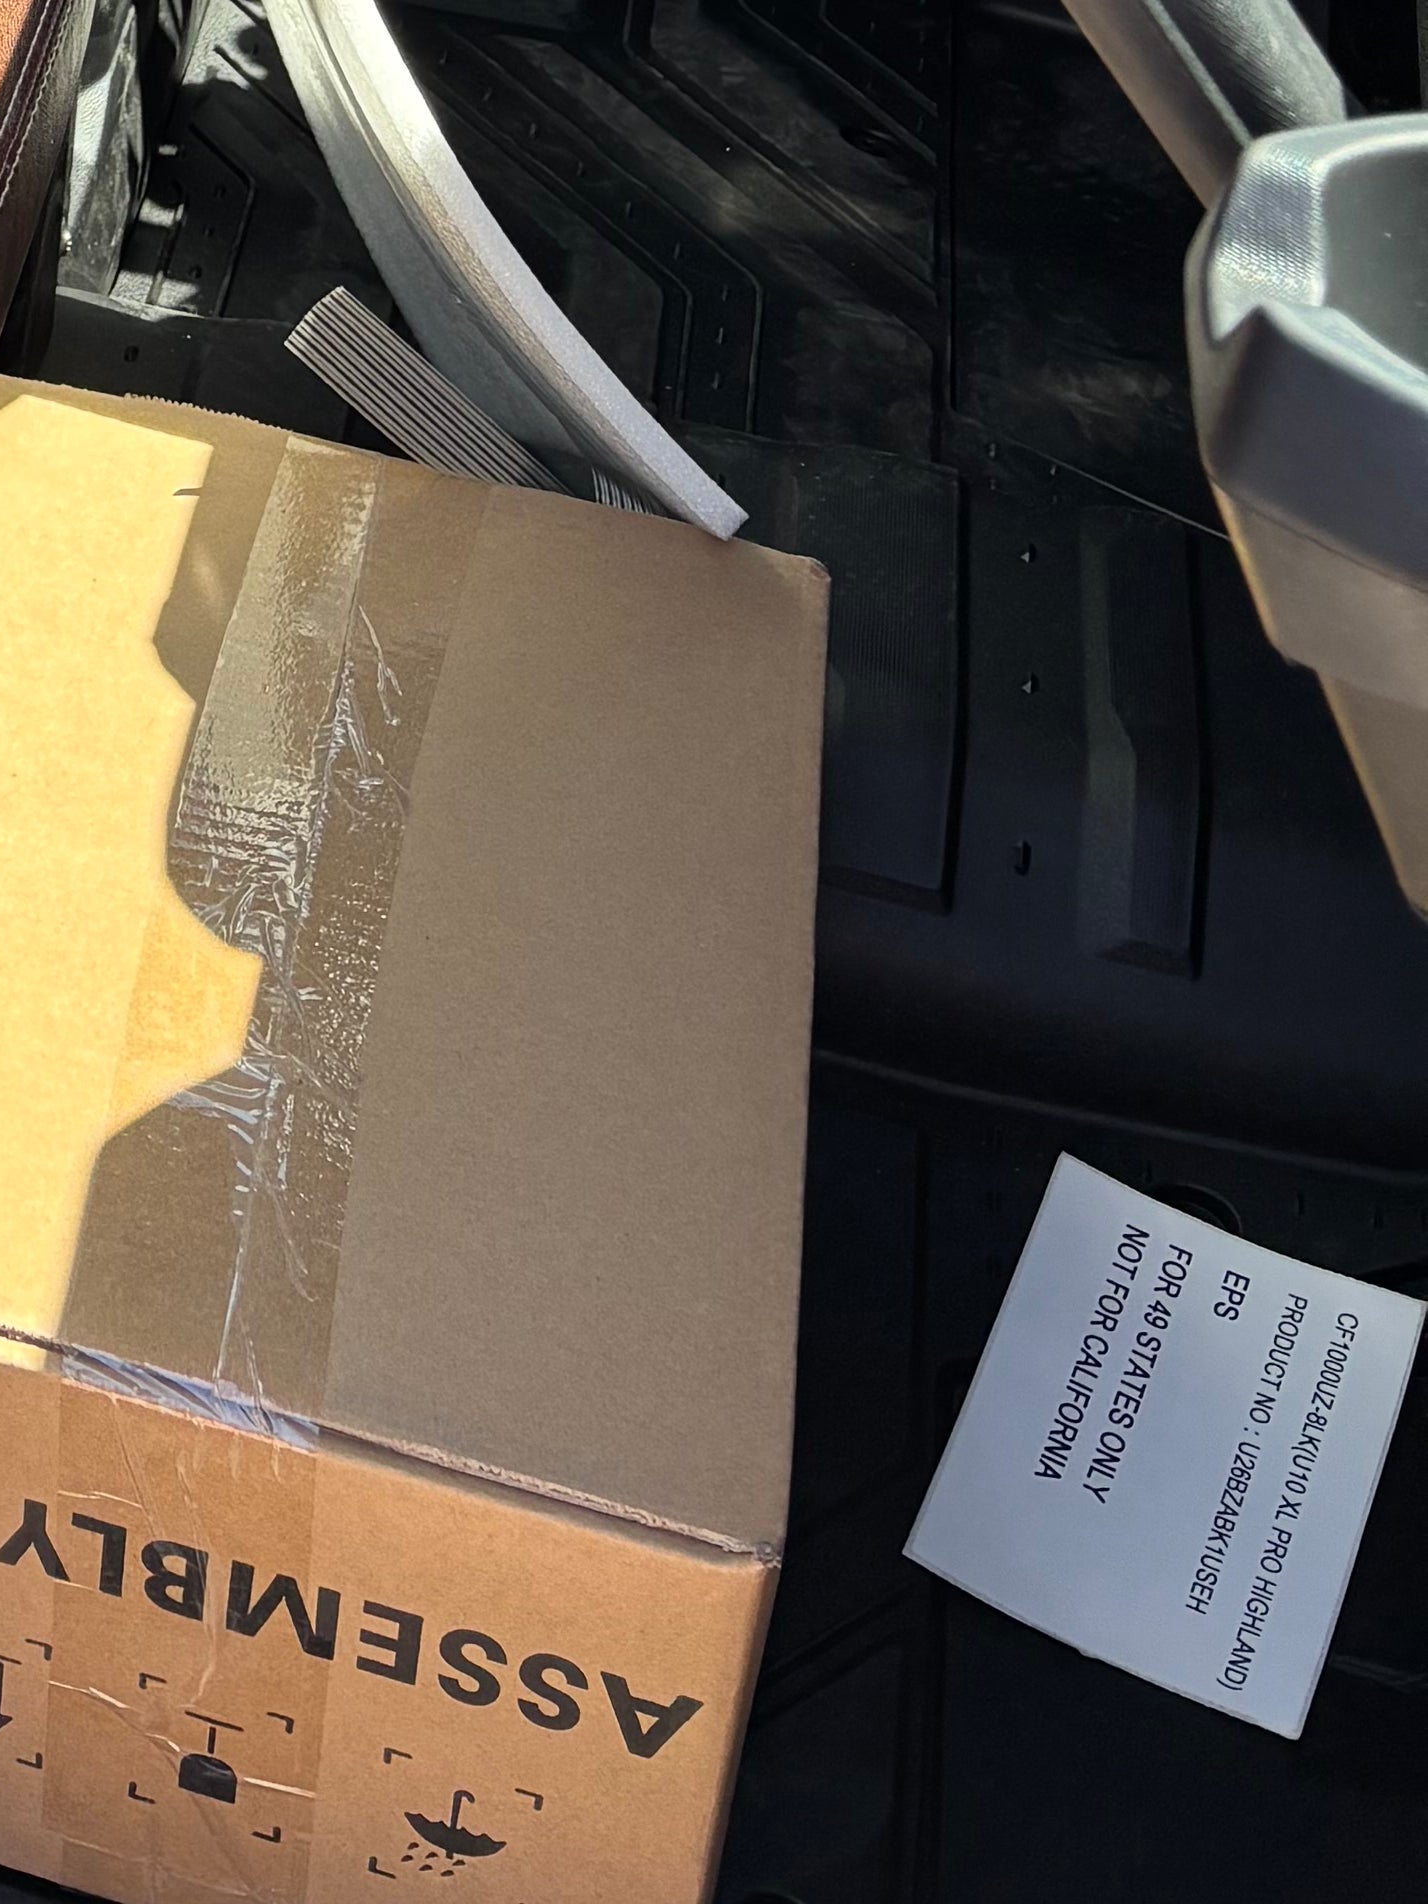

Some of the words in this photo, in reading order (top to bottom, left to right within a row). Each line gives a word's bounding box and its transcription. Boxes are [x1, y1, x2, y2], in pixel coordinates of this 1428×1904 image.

[1112, 1223, 1150, 1281] NOT
[1153, 1243, 1193, 1299] FOR
[1089, 1278, 1130, 1333] FOR
[1143, 1299, 1172, 1330] 49
[1213, 1269, 1251, 1321] EPS
[1260, 1293, 1308, 1392] PRODUCT
[1034, 1334, 1110, 1480] CALIFORNIA
[1107, 1331, 1162, 1429] STATES
[1249, 1392, 1276, 1424] NO
[1082, 1430, 1126, 1504] ONLY
[1185, 1441, 1261, 1615] U26BZABK1USEH
[1275, 1494, 1302, 1520] XL
[1260, 1526, 1293, 1574] PRO
[1216, 1575, 1277, 1692] HIGHLAND)
